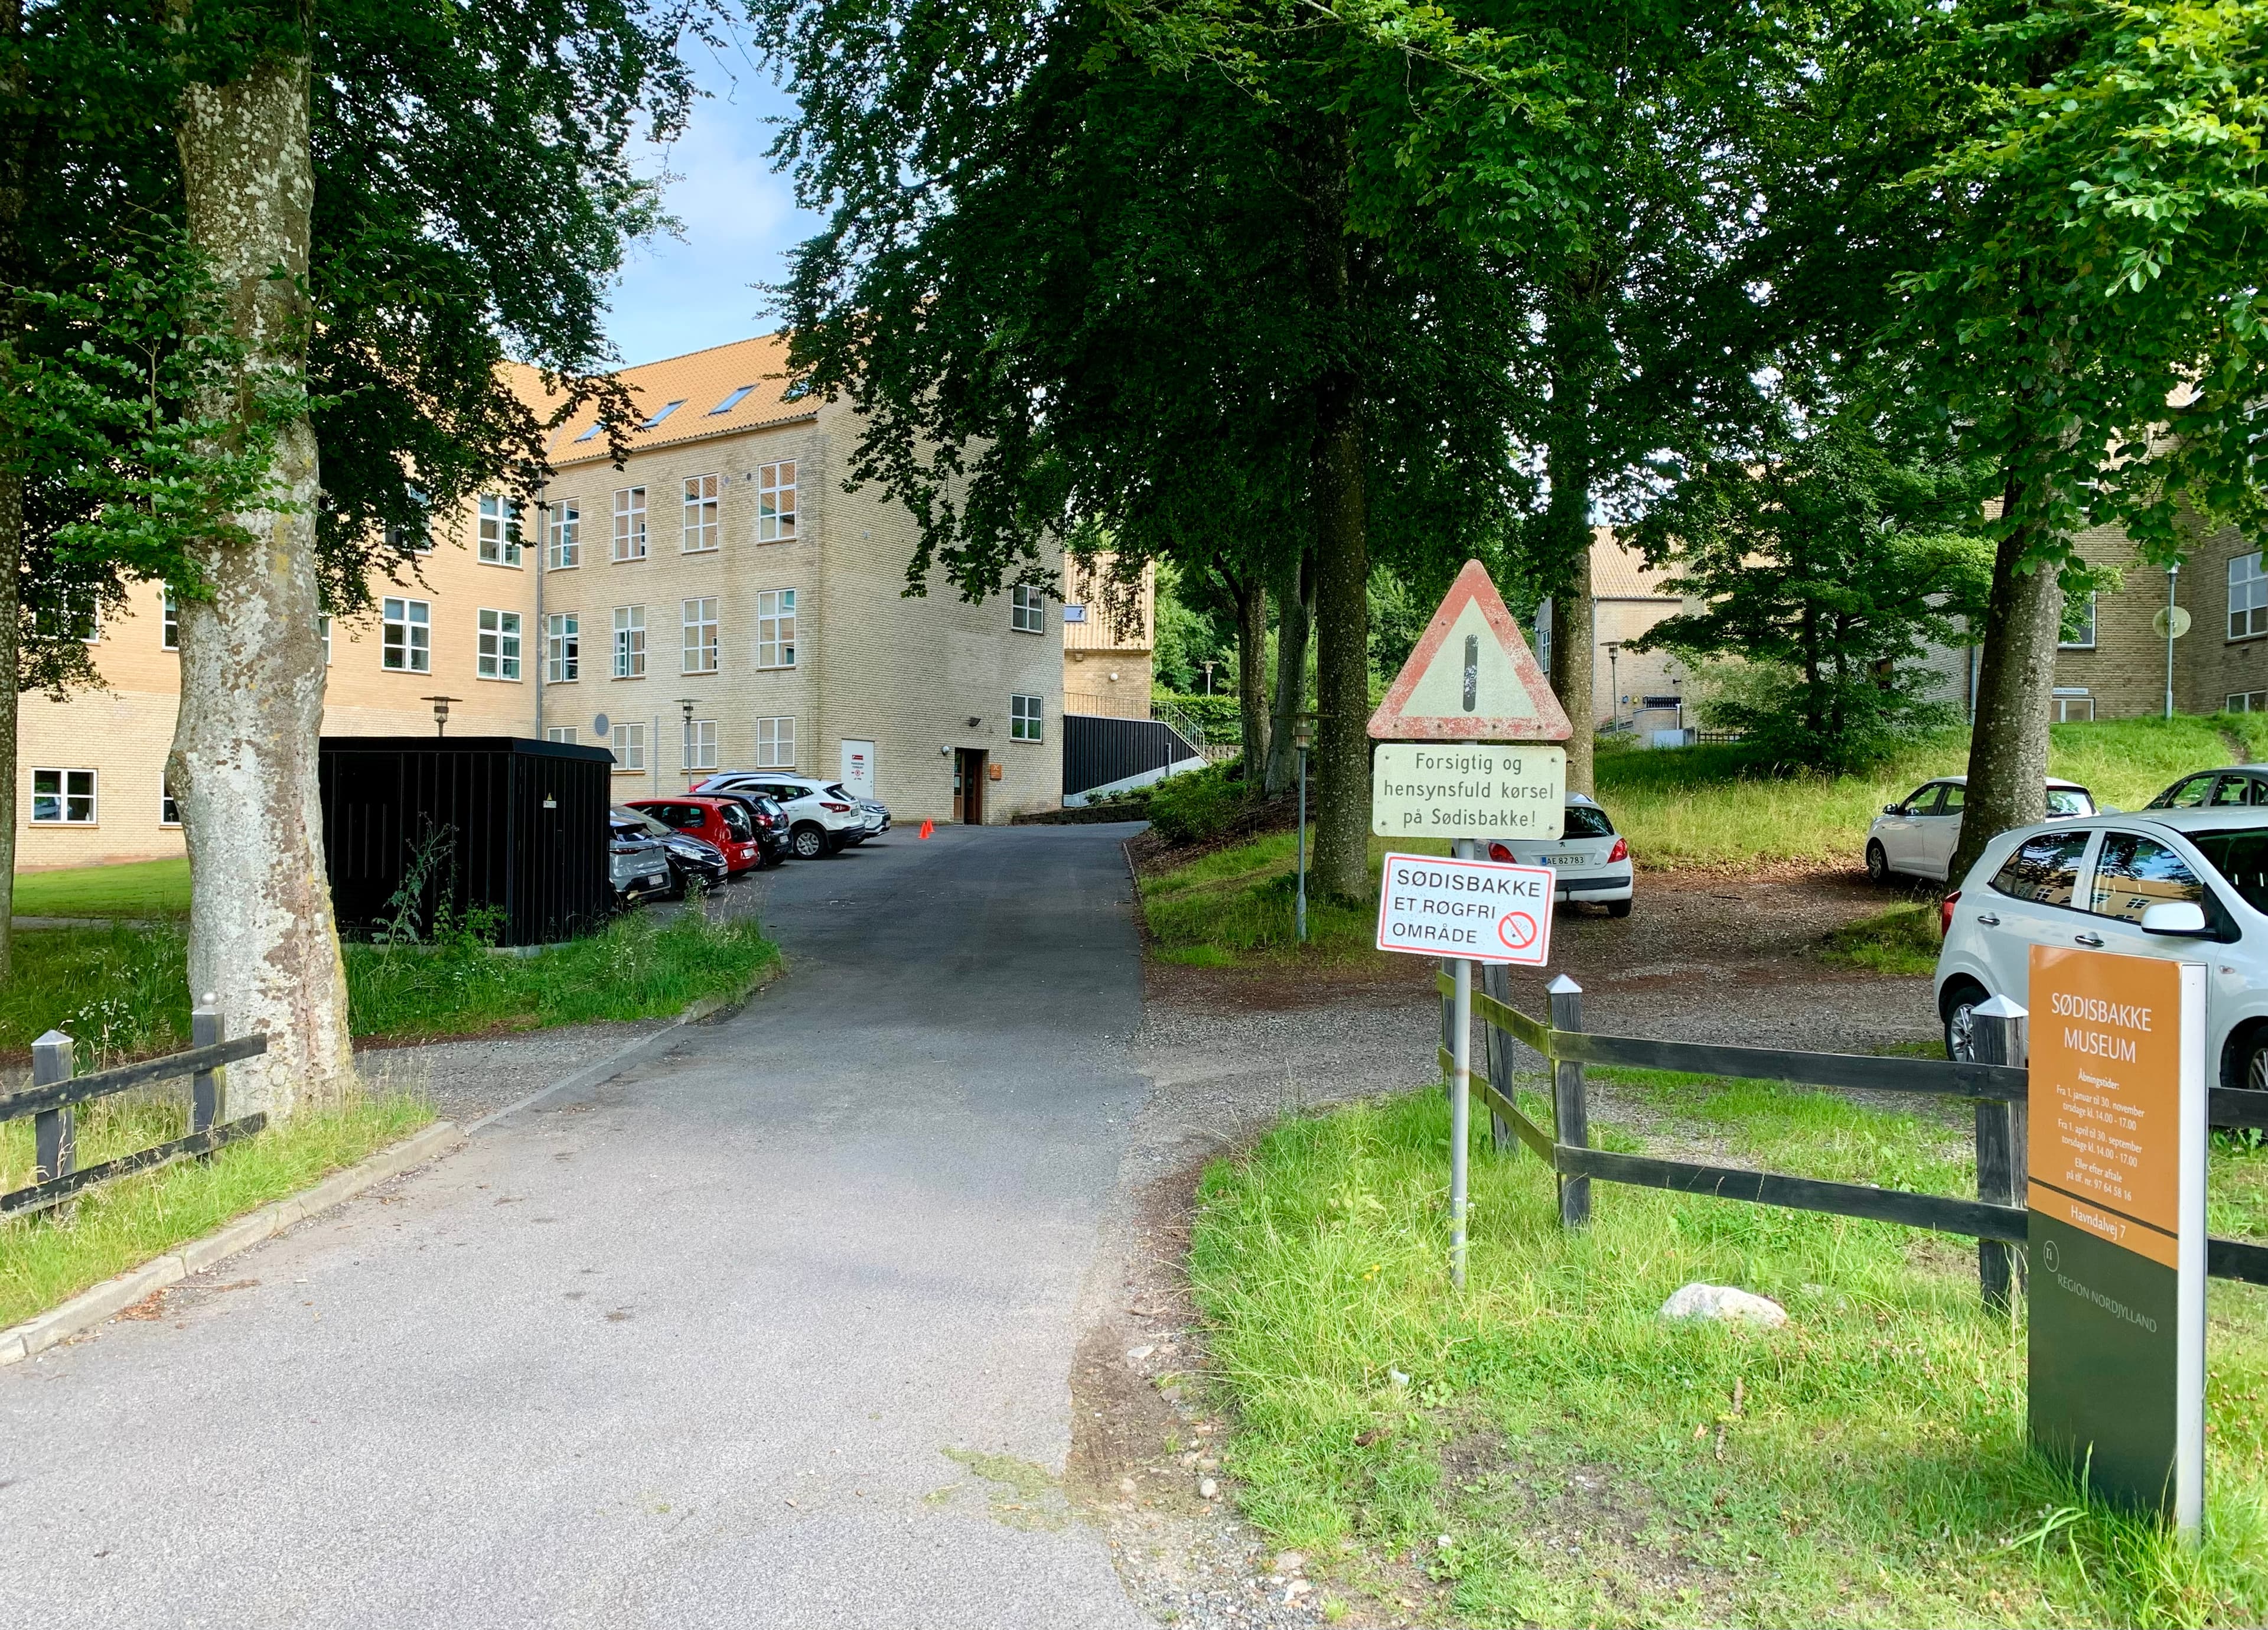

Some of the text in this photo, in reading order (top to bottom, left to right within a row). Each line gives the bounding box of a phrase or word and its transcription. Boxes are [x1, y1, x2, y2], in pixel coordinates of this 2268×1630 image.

[1416, 753, 1522, 775] Forsigtig og
[1384, 780, 1554, 801] hensynsfuld kørsel
[1403, 808, 1536, 828] på Sødisbakke!
[1396, 868, 1541, 897] SØDISBAKKE
[1394, 896, 1495, 919] ET RØGFRI
[1392, 922, 1477, 943] OMRÅDE
[2051, 992, 2152, 1032] SØDISBAKKE
[2064, 1027, 2136, 1063] MUSEUM
[2078, 1068, 2120, 1090] Åbningstider:
[2057, 1085, 2066, 1096] Fra
[2067, 1088, 2072, 1097] 1.
[2073, 1089, 2092, 1101] januar
[2101, 1097, 2111, 1108] 30.
[2113, 1102, 2145, 1117] november
[2062, 1101, 2086, 1118] tirsdage
[2096, 1111, 2113, 1124] 14.00
[2119, 1117, 2136, 1130] 17.00
[2058, 1118, 2067, 1130] Fra
[2069, 1123, 2074, 1131] 1.
[2075, 1126, 2088, 1137] april
[2097, 1131, 2107, 1142] 30.
[2109, 1137, 2143, 1153] september
[2062, 1136, 2087, 1152] torsdage
[2097, 1146, 2114, 1159] 14.00
[2120, 1153, 2137, 1167] 17.00
[2075, 1157, 2122, 1183] Eller efter aftale
[2066, 1169, 2074, 1181] på
[2084, 1178, 2093, 1187] nr.
[2094, 1179, 2102, 1190] 97
[2104, 1183, 2112, 1193] 64
[2113, 1186, 2122, 1198] 58
[2124, 1190, 2132, 1201] 16
[2071, 1205, 2126, 1241] Havndalvej 7
[2058, 1273, 2157, 1332] REGION NORDJYLLAND
